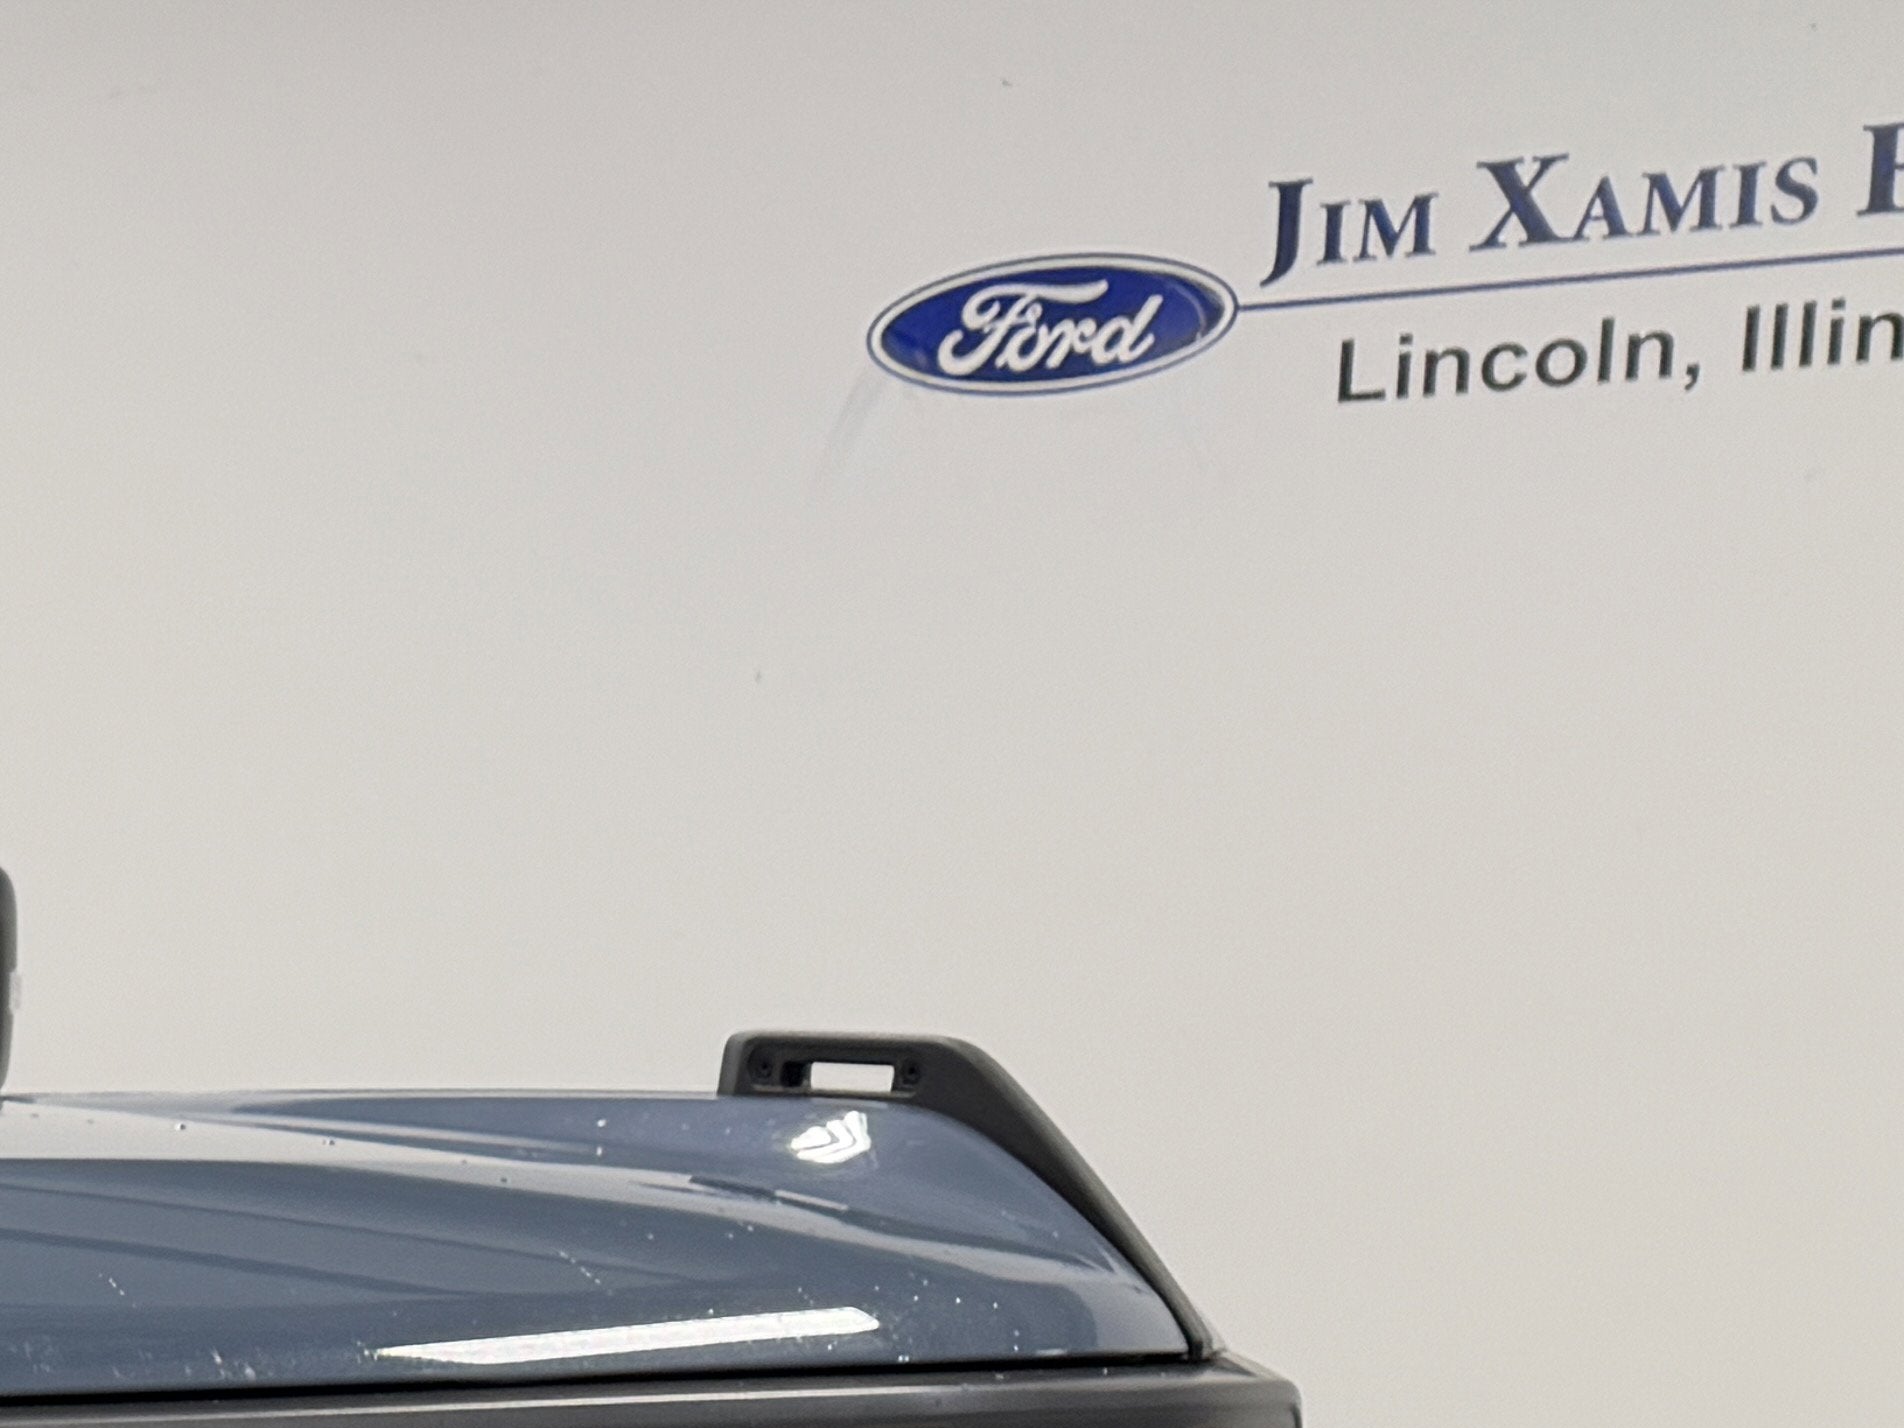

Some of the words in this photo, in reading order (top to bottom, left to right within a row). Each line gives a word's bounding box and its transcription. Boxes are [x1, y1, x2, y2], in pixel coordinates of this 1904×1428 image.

[1259, 178, 1439, 287] JIM
[1469, 153, 1819, 251] XAMIS
[936, 277, 1163, 375] Ford
[1336, 317, 1700, 404] Lincoln,
